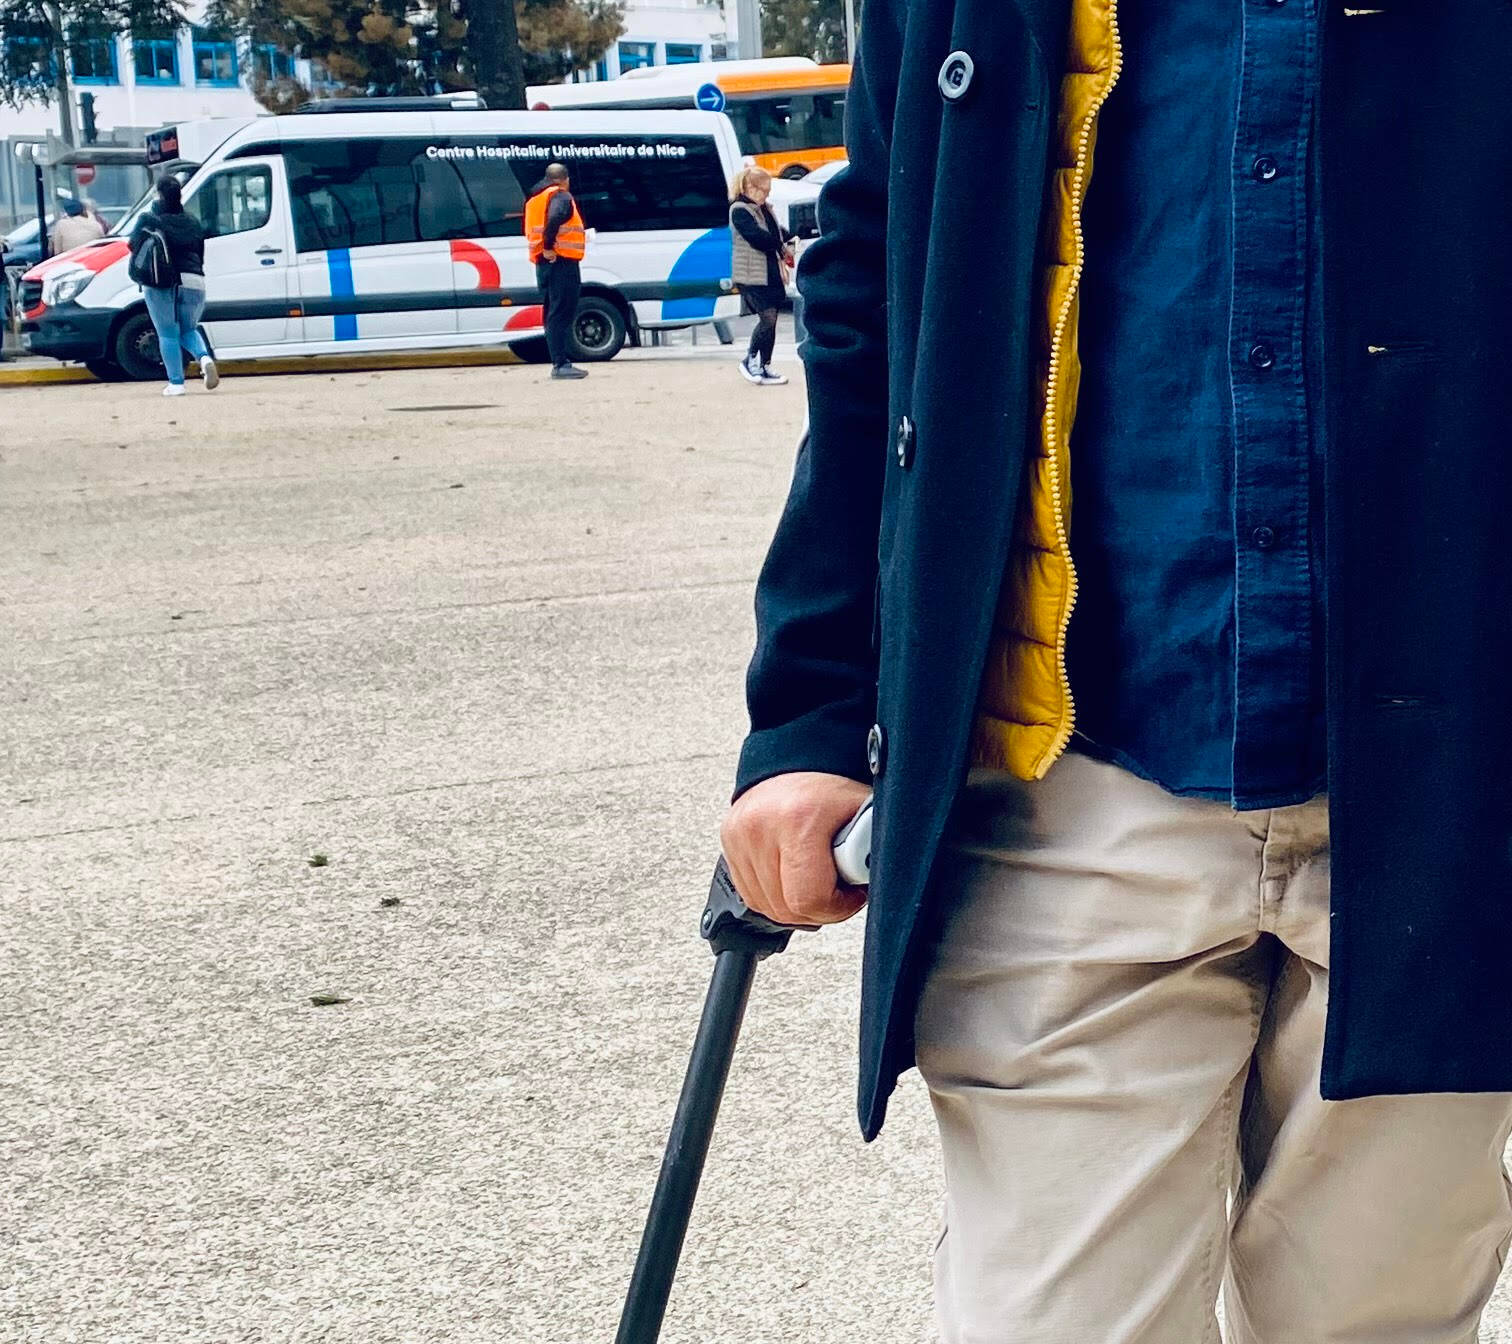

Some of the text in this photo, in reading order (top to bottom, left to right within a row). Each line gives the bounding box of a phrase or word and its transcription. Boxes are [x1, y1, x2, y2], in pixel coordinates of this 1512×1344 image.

[426, 143, 686, 160] Centre Hospitalier Universitaire de Nice
